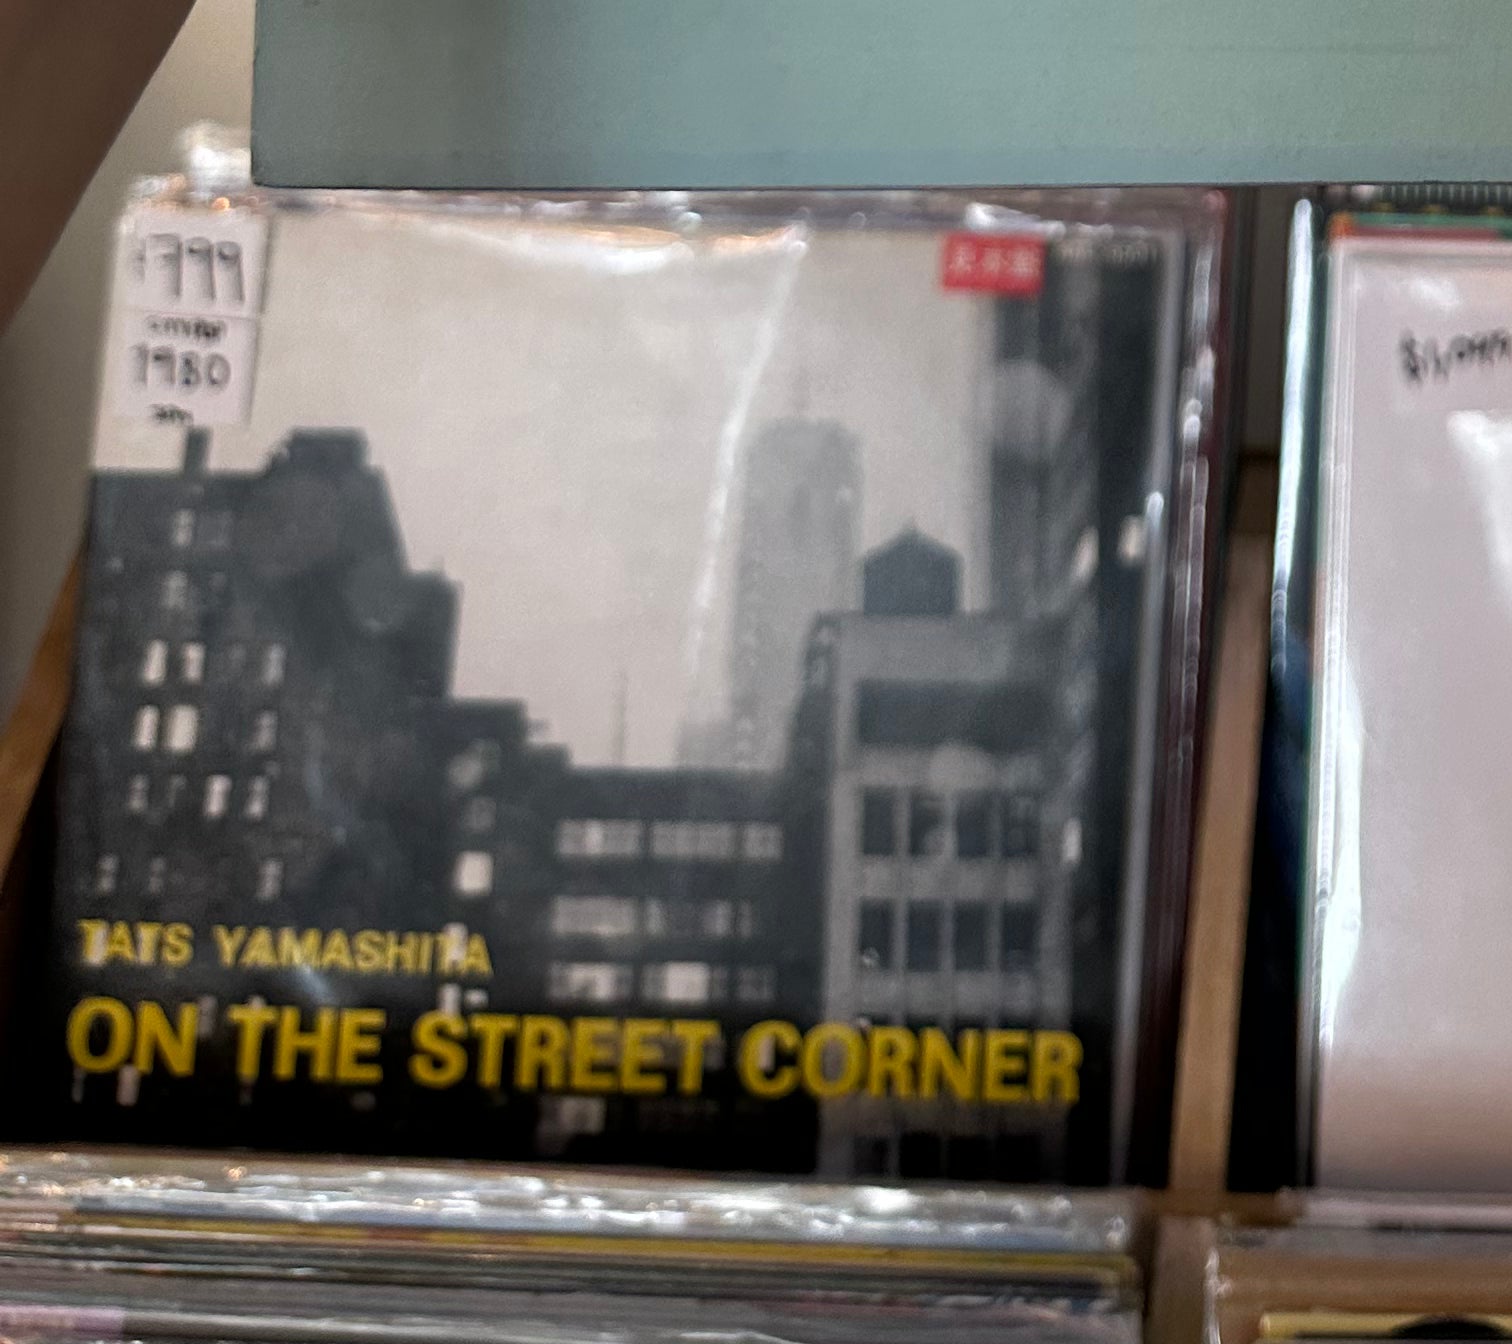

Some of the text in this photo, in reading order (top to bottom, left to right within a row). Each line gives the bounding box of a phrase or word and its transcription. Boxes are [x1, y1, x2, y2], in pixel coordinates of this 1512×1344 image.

[77, 918, 493, 977] TATS YAMASHITA
[66, 996, 1085, 1103] ON THE STREET CORNER
